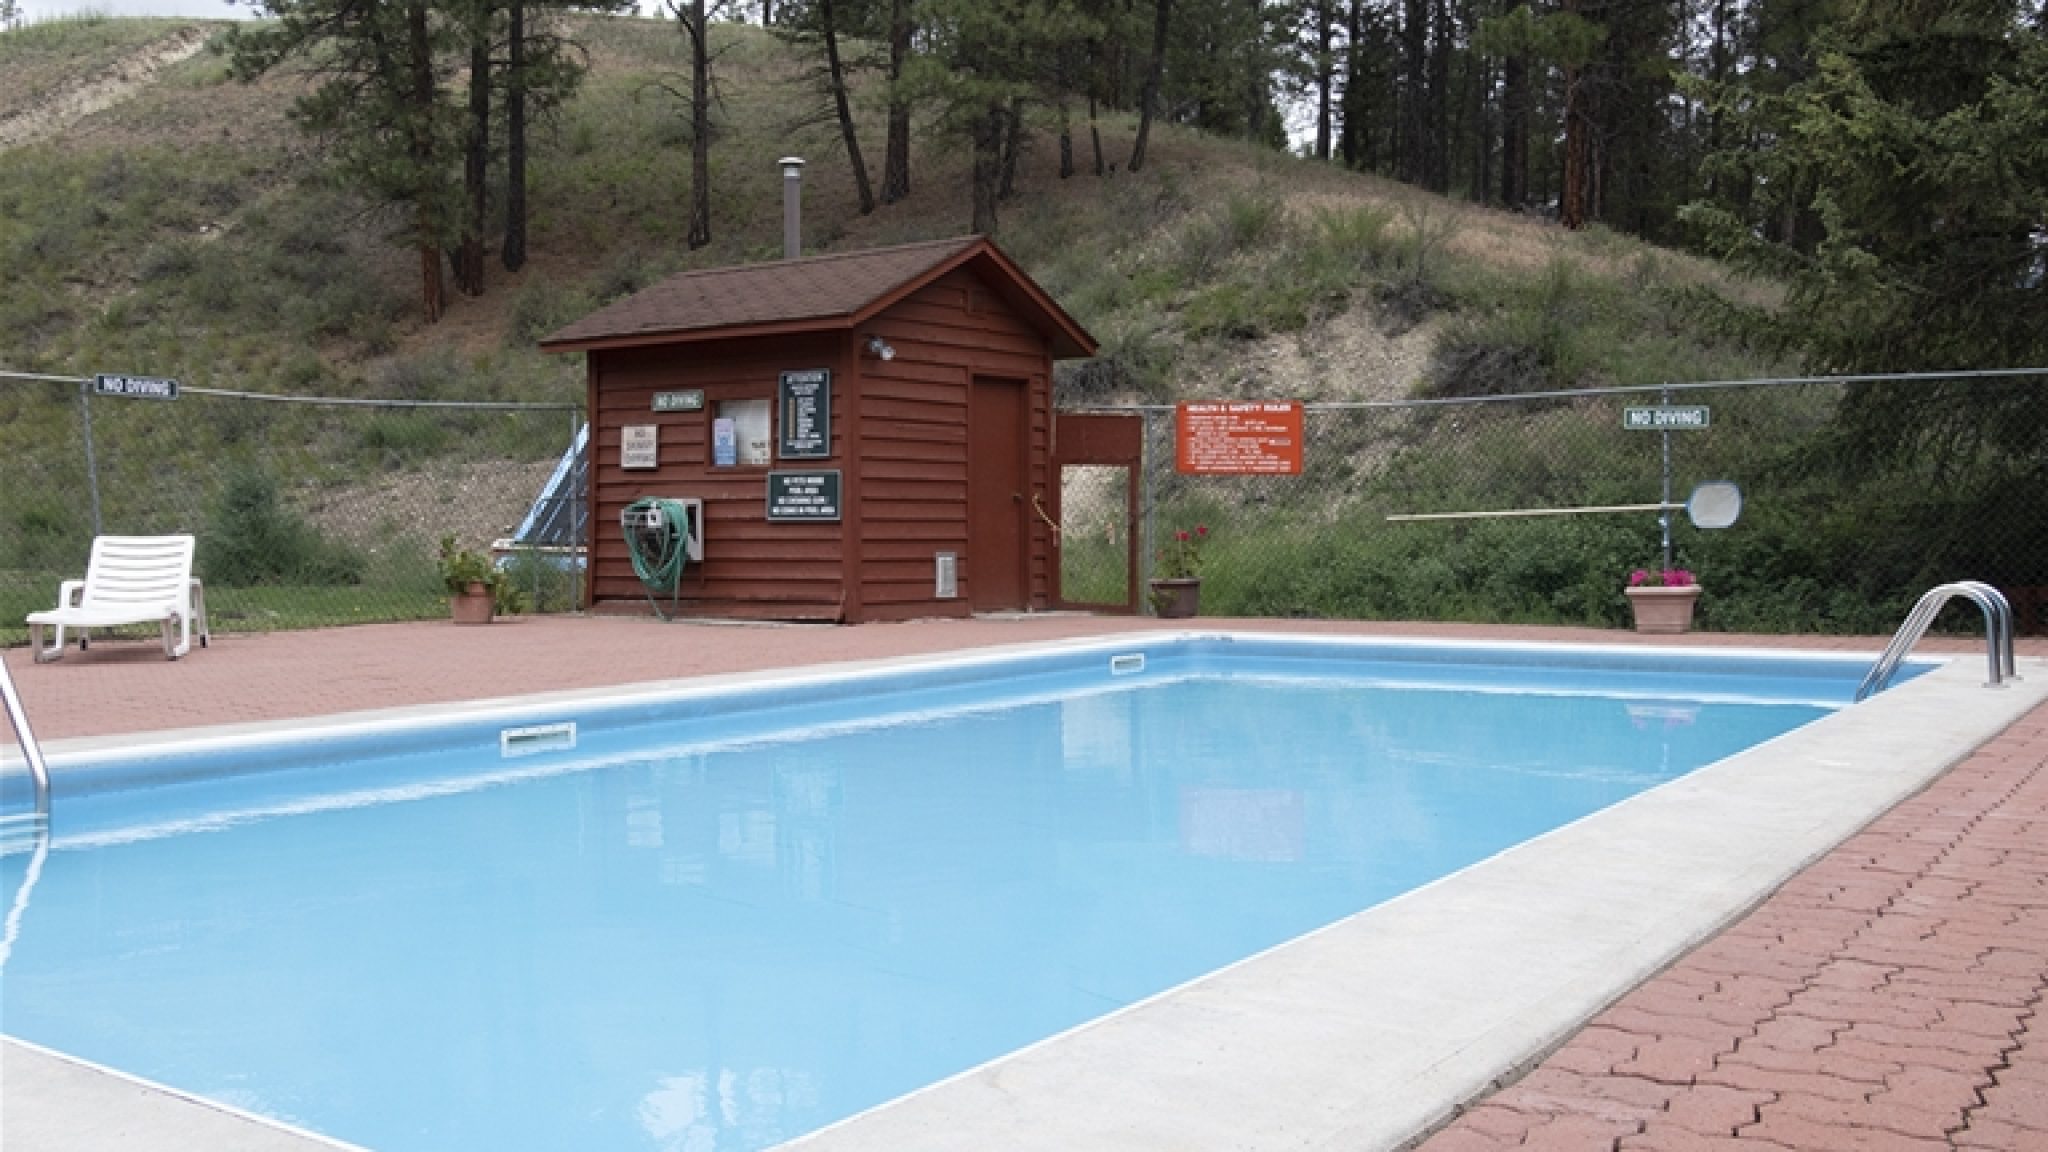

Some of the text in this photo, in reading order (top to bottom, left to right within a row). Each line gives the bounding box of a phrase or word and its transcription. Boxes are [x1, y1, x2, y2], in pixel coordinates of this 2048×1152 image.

[104, 376, 169, 395] NO DIVING
[657, 394, 699, 407] NO DIVING
[1186, 404, 1218, 412] HEALTH
[1229, 404, 1261, 412] SAFETY
[1263, 404, 1291, 412] RULES
[1632, 410, 1702, 424] NO DIVING
